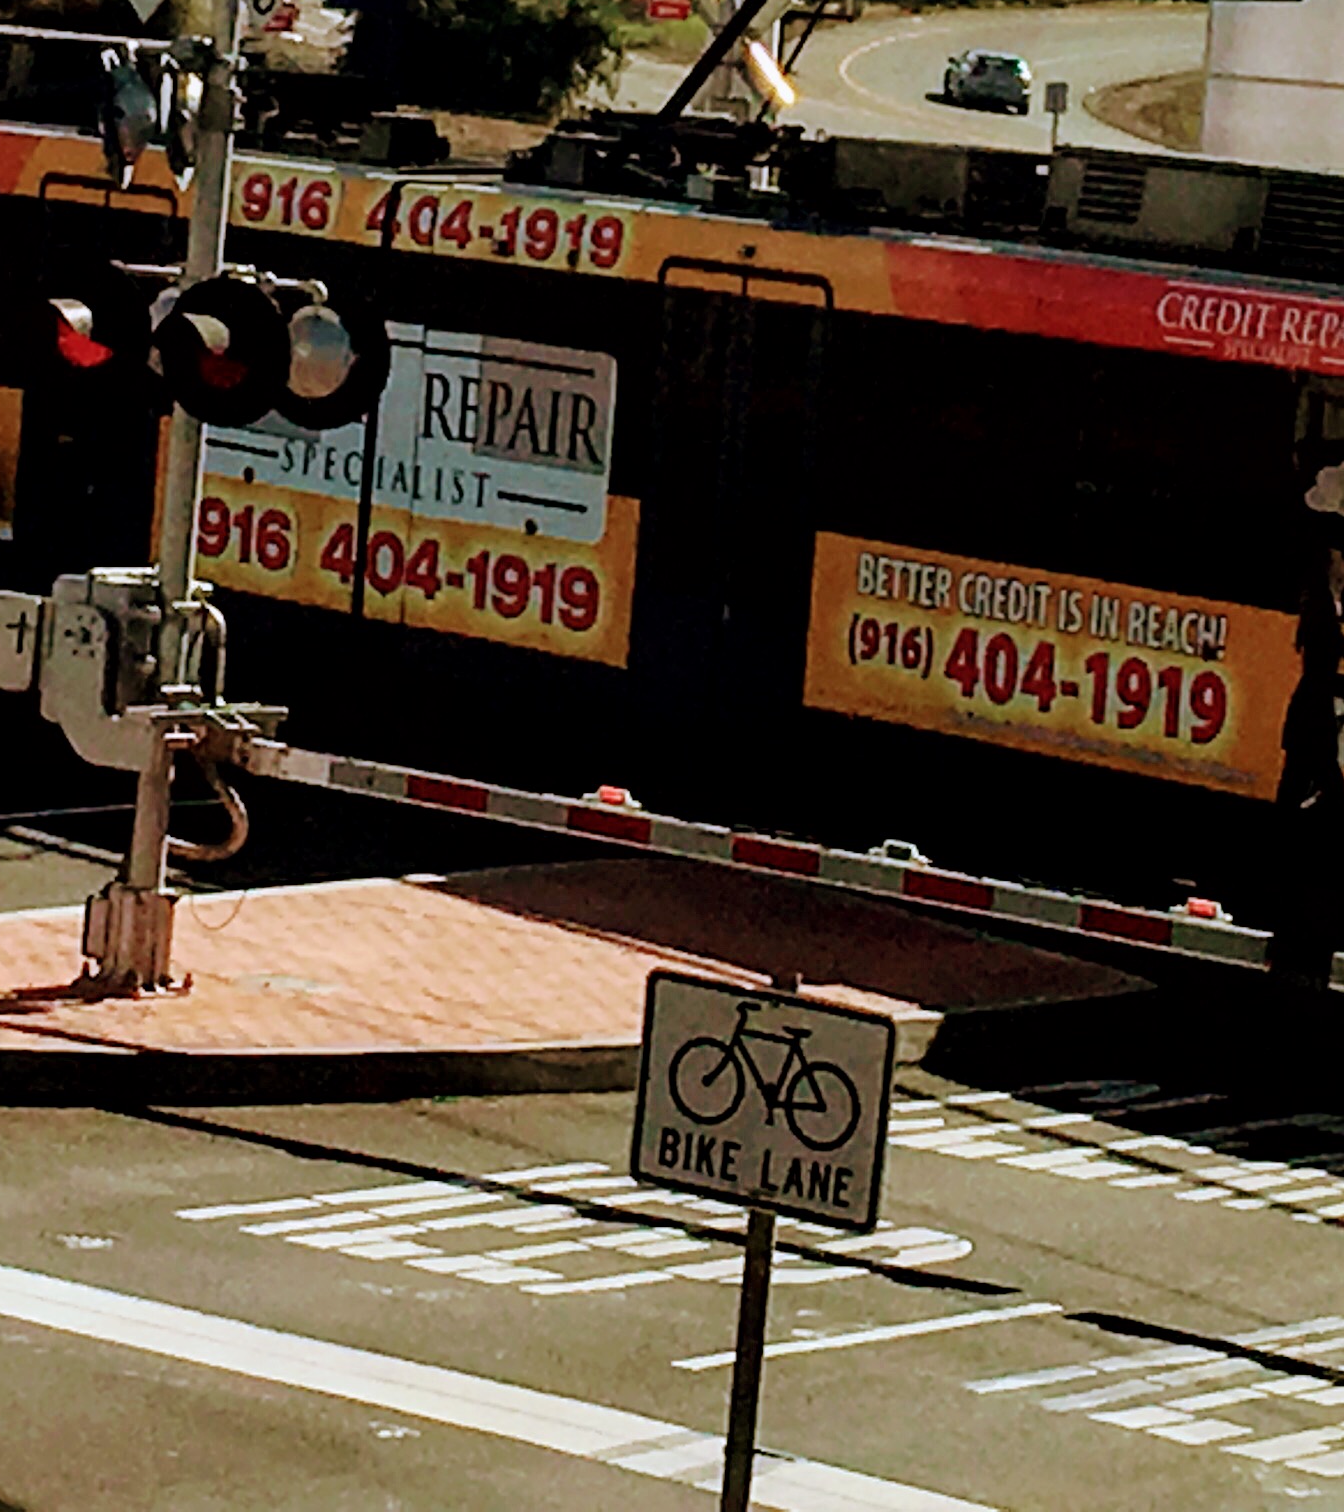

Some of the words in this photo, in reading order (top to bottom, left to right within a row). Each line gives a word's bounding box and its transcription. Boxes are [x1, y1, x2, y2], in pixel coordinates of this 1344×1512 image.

[240, 171, 334, 232] 916
[364, 189, 625, 270] 404-1919
[1156, 290, 1277, 341] CREDIT
[422, 371, 604, 466] REPAIR
[279, 438, 493, 510] SPECIALIST
[197, 496, 291, 573] 916
[319, 520, 601, 634] 404-1919
[856, 551, 954, 611] BETTER
[957, 570, 1054, 630] CREDIT
[1056, 588, 1084, 634] IS
[1089, 592, 1122, 641] IN
[1127, 600, 1229, 662] REACH!
[847, 613, 935, 680] (916)
[944, 627, 1228, 745] 404-1919
[657, 1126, 743, 1183] BIKE
[760, 1147, 855, 1209] LANE
